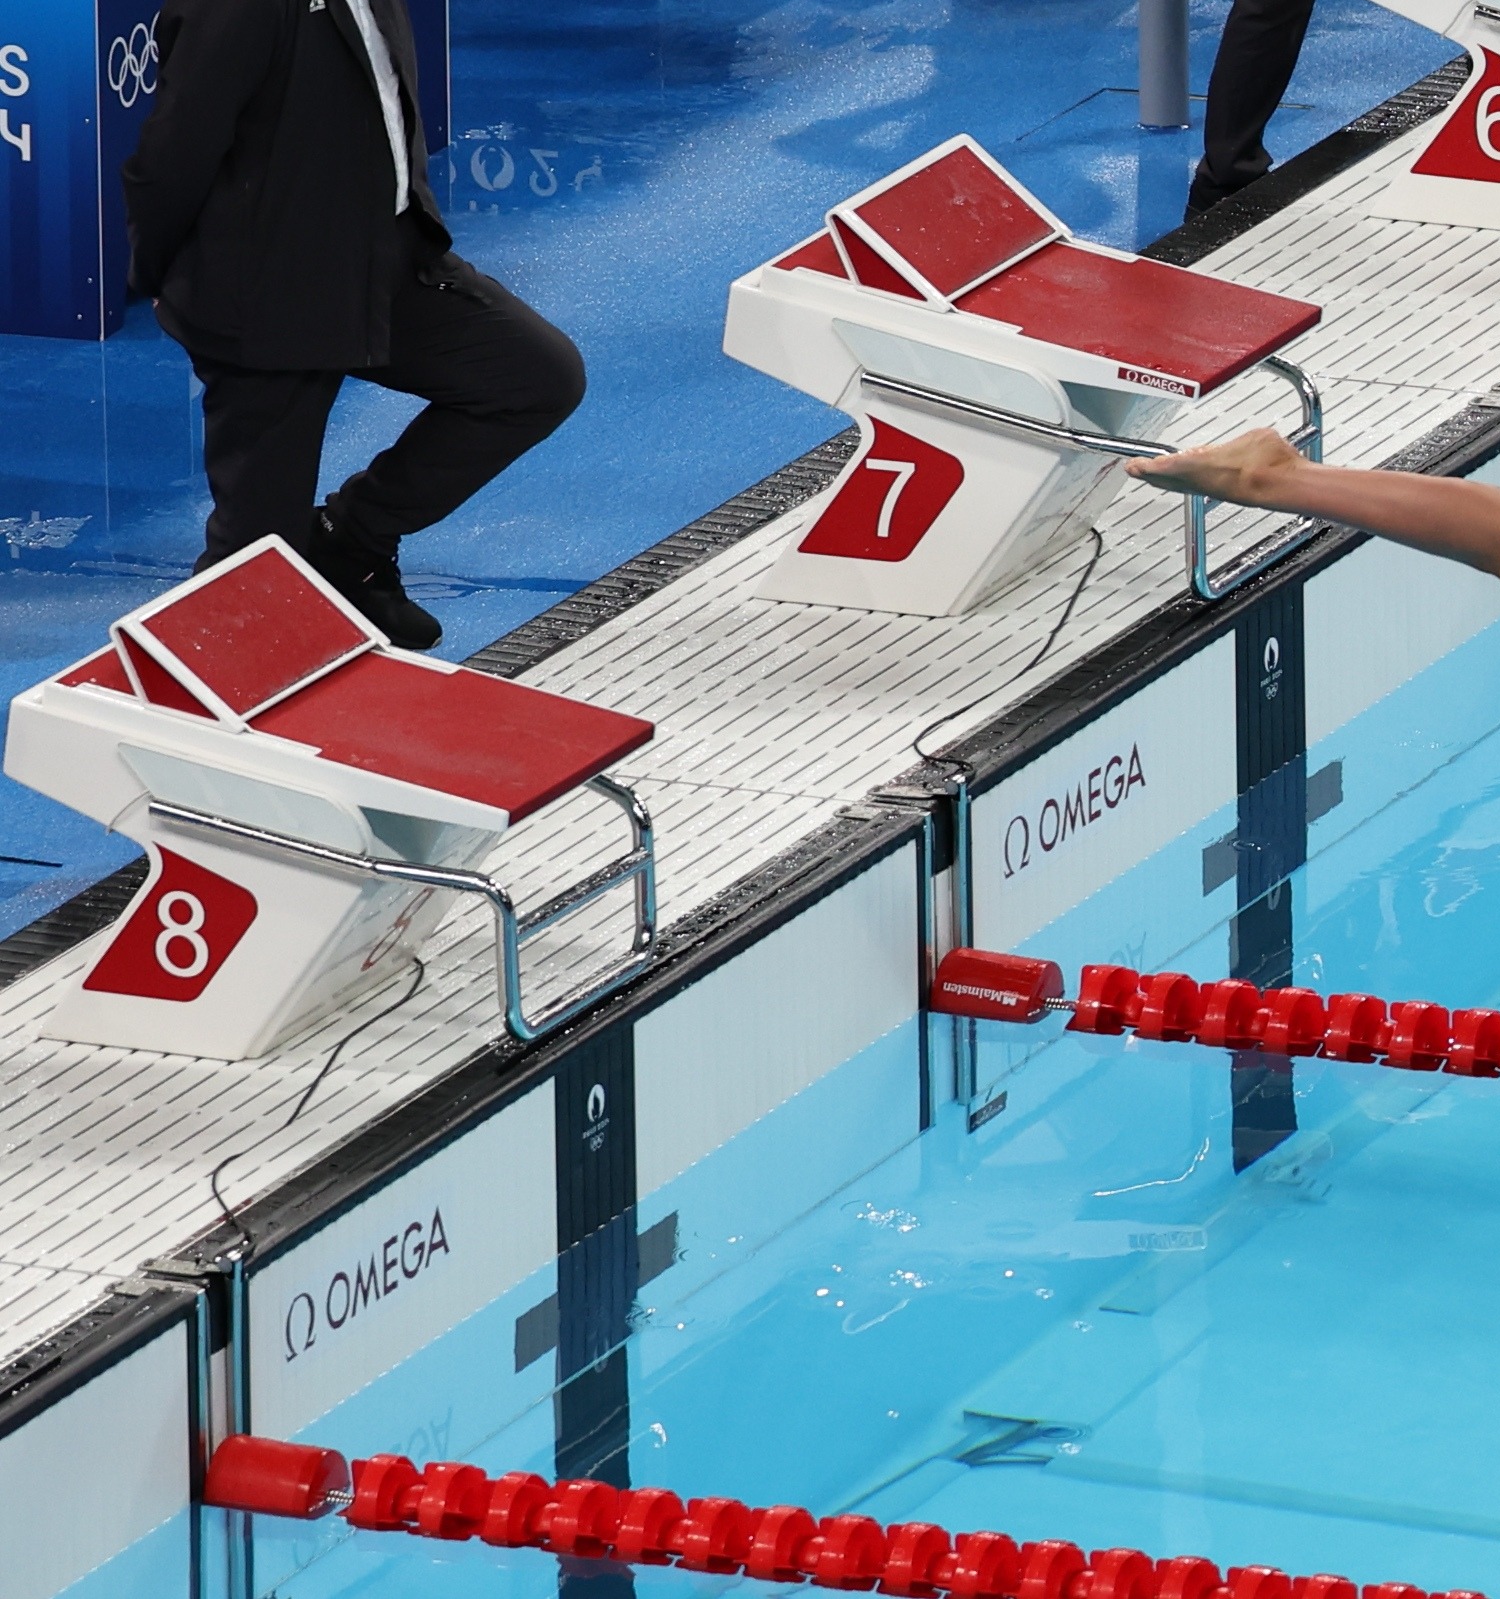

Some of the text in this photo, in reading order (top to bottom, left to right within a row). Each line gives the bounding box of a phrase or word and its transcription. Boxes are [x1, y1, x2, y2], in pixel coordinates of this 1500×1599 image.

[1141, 375, 1186, 395] OMEGA
[866, 458, 915, 538] 7
[1040, 740, 1146, 852] OMEGA
[155, 890, 209, 978] 8
[326, 1205, 450, 1330] OMEGA
